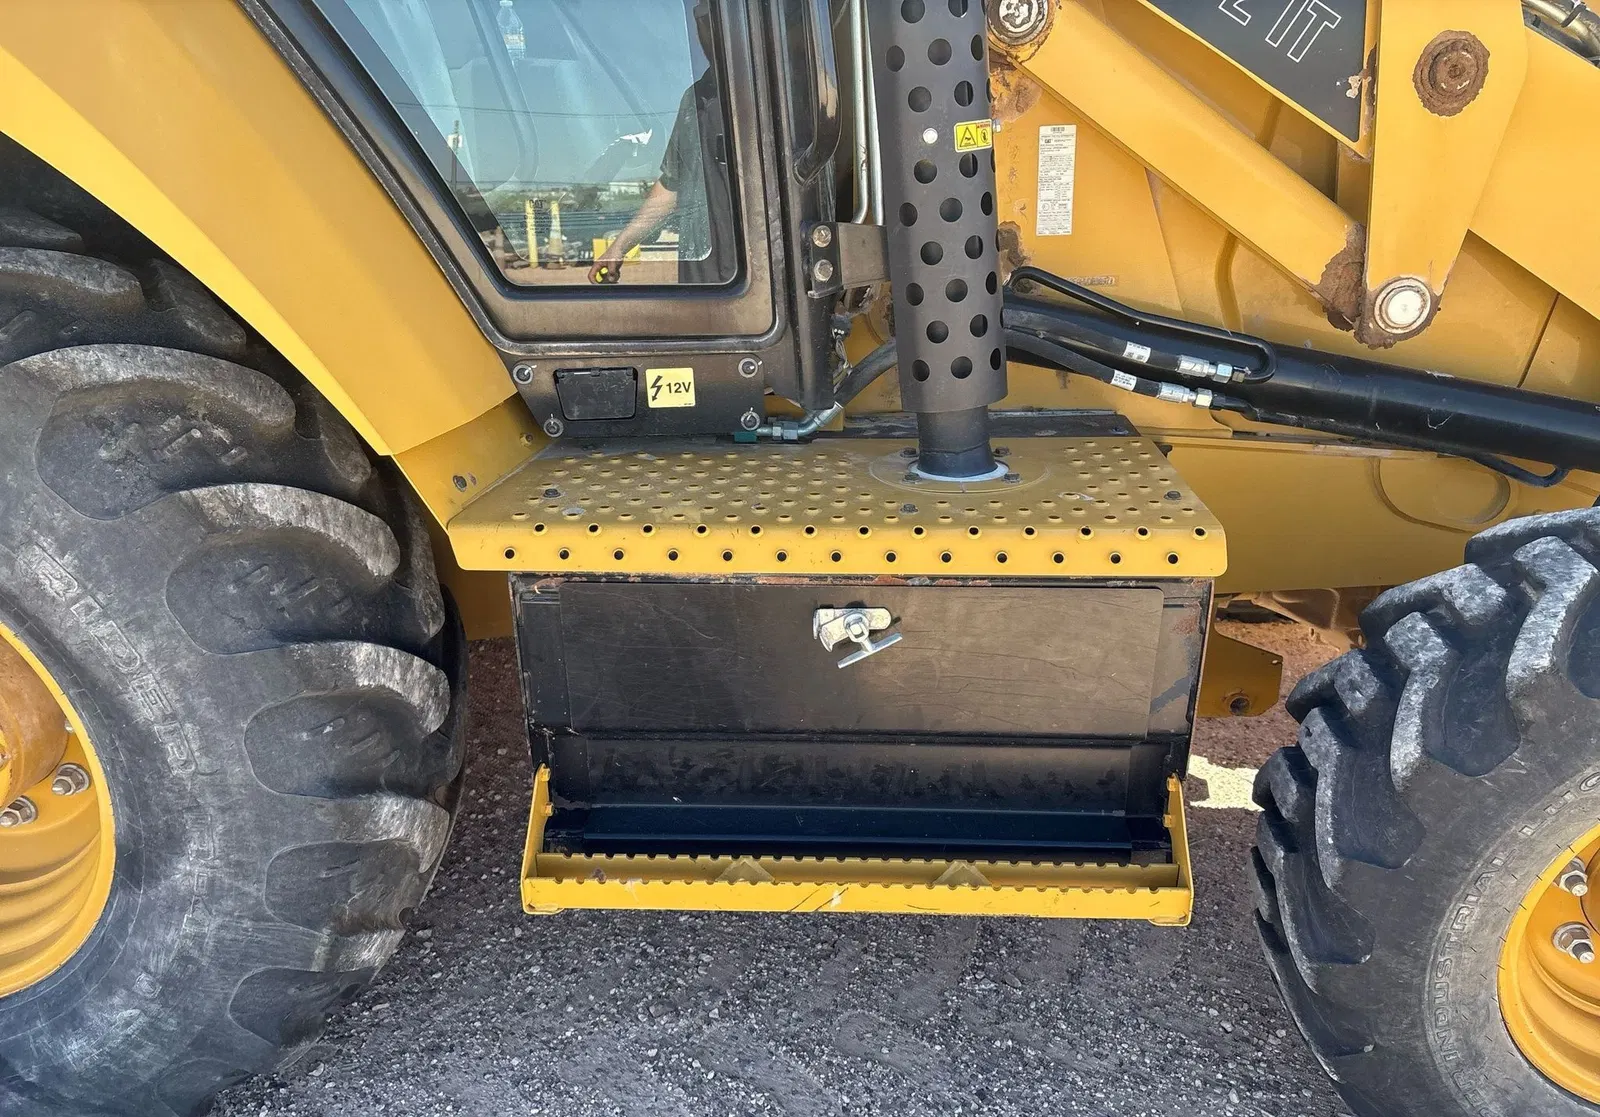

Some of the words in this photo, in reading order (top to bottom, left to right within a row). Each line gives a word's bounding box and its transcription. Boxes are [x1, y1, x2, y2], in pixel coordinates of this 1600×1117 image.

[1265, 0, 1342, 63] IT
[666, 382, 691, 394] 12V
[1433, 848, 1519, 1063] INDUSTRIAL
